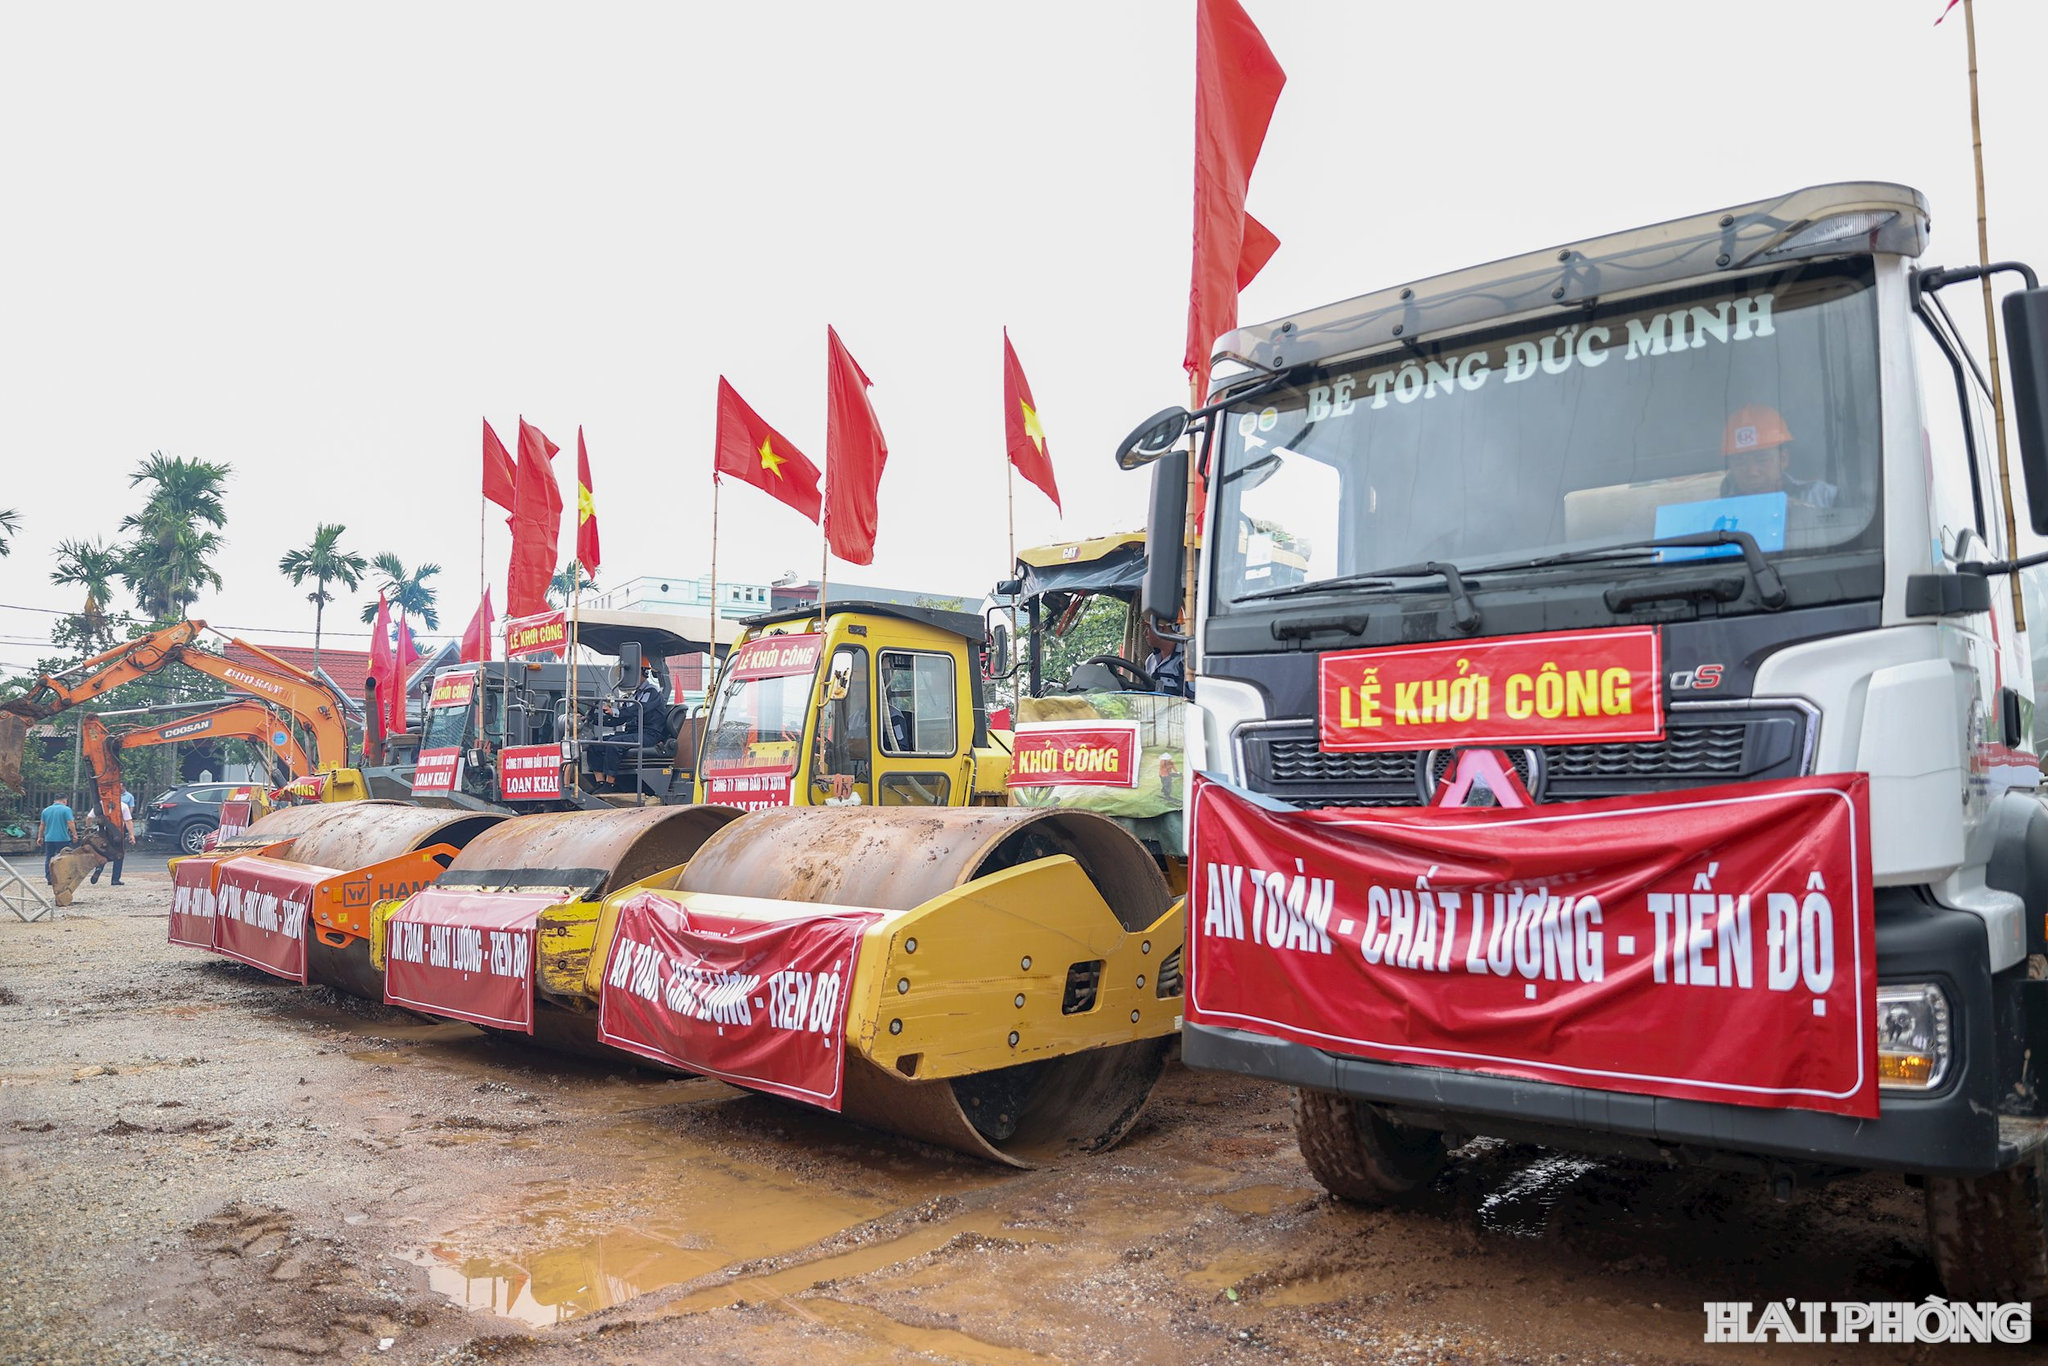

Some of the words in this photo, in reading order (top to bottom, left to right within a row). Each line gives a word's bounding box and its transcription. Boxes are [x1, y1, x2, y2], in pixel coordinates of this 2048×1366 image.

[1305, 373, 1356, 423] BÊ
[1367, 351, 1491, 410] TÔNG
[1503, 325, 1611, 384] ĐỨC
[1624, 293, 1776, 361] MINH
[540, 622, 563, 643] CÔNG
[750, 642, 779, 669] KHỞI
[780, 644, 815, 667] CÔNG
[1339, 667, 1383, 729] LỄ
[1395, 658, 1490, 726] KHỞI
[1505, 662, 1632, 719] CÔNG
[165, 720, 209, 738] DOOSAN
[1018, 740, 1058, 774] KHỞI
[1062, 744, 1119, 773] CÔNG
[506, 777, 532, 793] LOAN
[533, 769, 559, 793] KHẢI
[379, 880, 431, 900] HAM
[1204, 862, 1245, 941] AN
[1249, 857, 1335, 955] TOÀN
[1360, 865, 1461, 973] CHẤT
[1466, 886, 1604, 1000] LƯỢNG
[1647, 861, 1753, 989] TIẾN
[1766, 871, 1835, 1016] ĐỘ
[767, 958, 813, 1031] TIẾN
[809, 959, 842, 1048] ĐỘ
